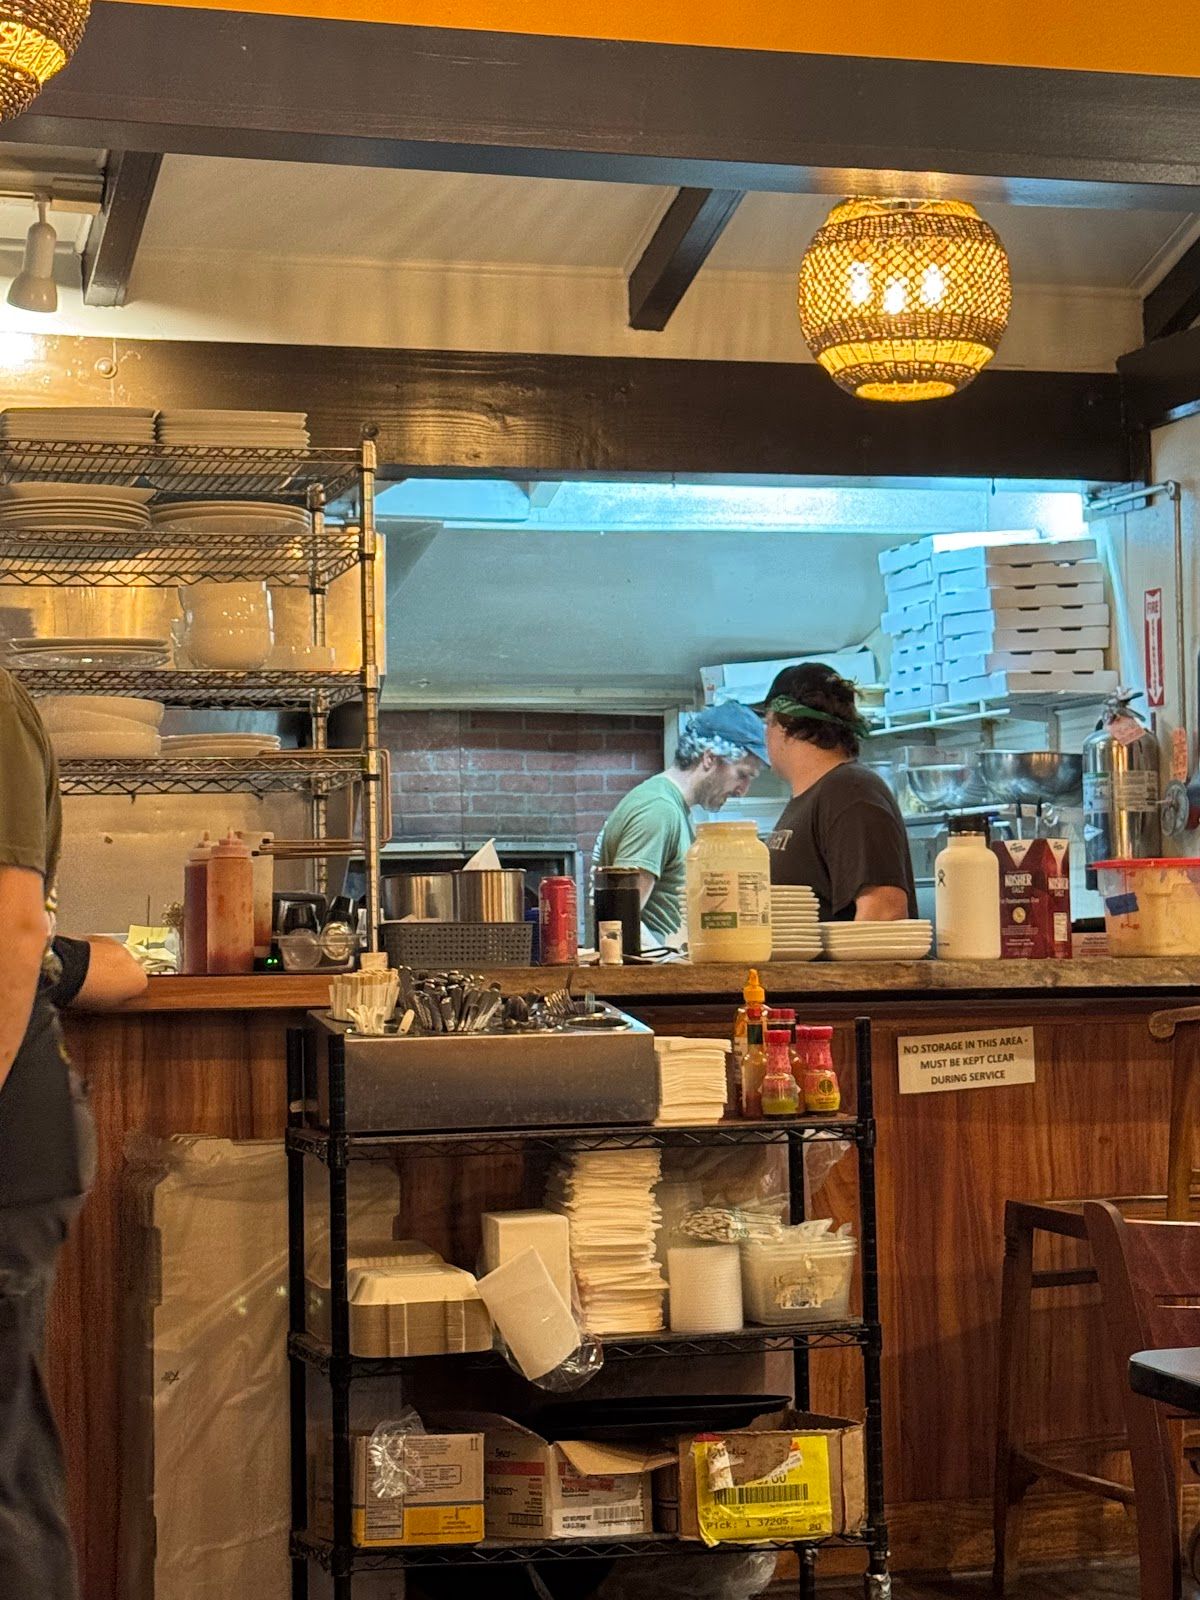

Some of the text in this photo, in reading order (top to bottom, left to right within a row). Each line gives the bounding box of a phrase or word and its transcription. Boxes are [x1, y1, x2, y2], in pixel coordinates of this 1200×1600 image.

[1147, 600, 1159, 613] FIRE
[1004, 874, 1032, 887] KOSHER
[903, 1045, 919, 1054] NO
[920, 1041, 963, 1053] STORAGE
[965, 1040, 975, 1049] IN
[977, 1039, 997, 1048] THIS
[999, 1036, 1023, 1046] AREA
[920, 1053, 1015, 1069] MUST BE KEPT CLEAR
[931, 1070, 1005, 1085] DURING SERVICE
[706, 1520, 737, 1530] Pick:
[759, 1517, 789, 1527] 37205
